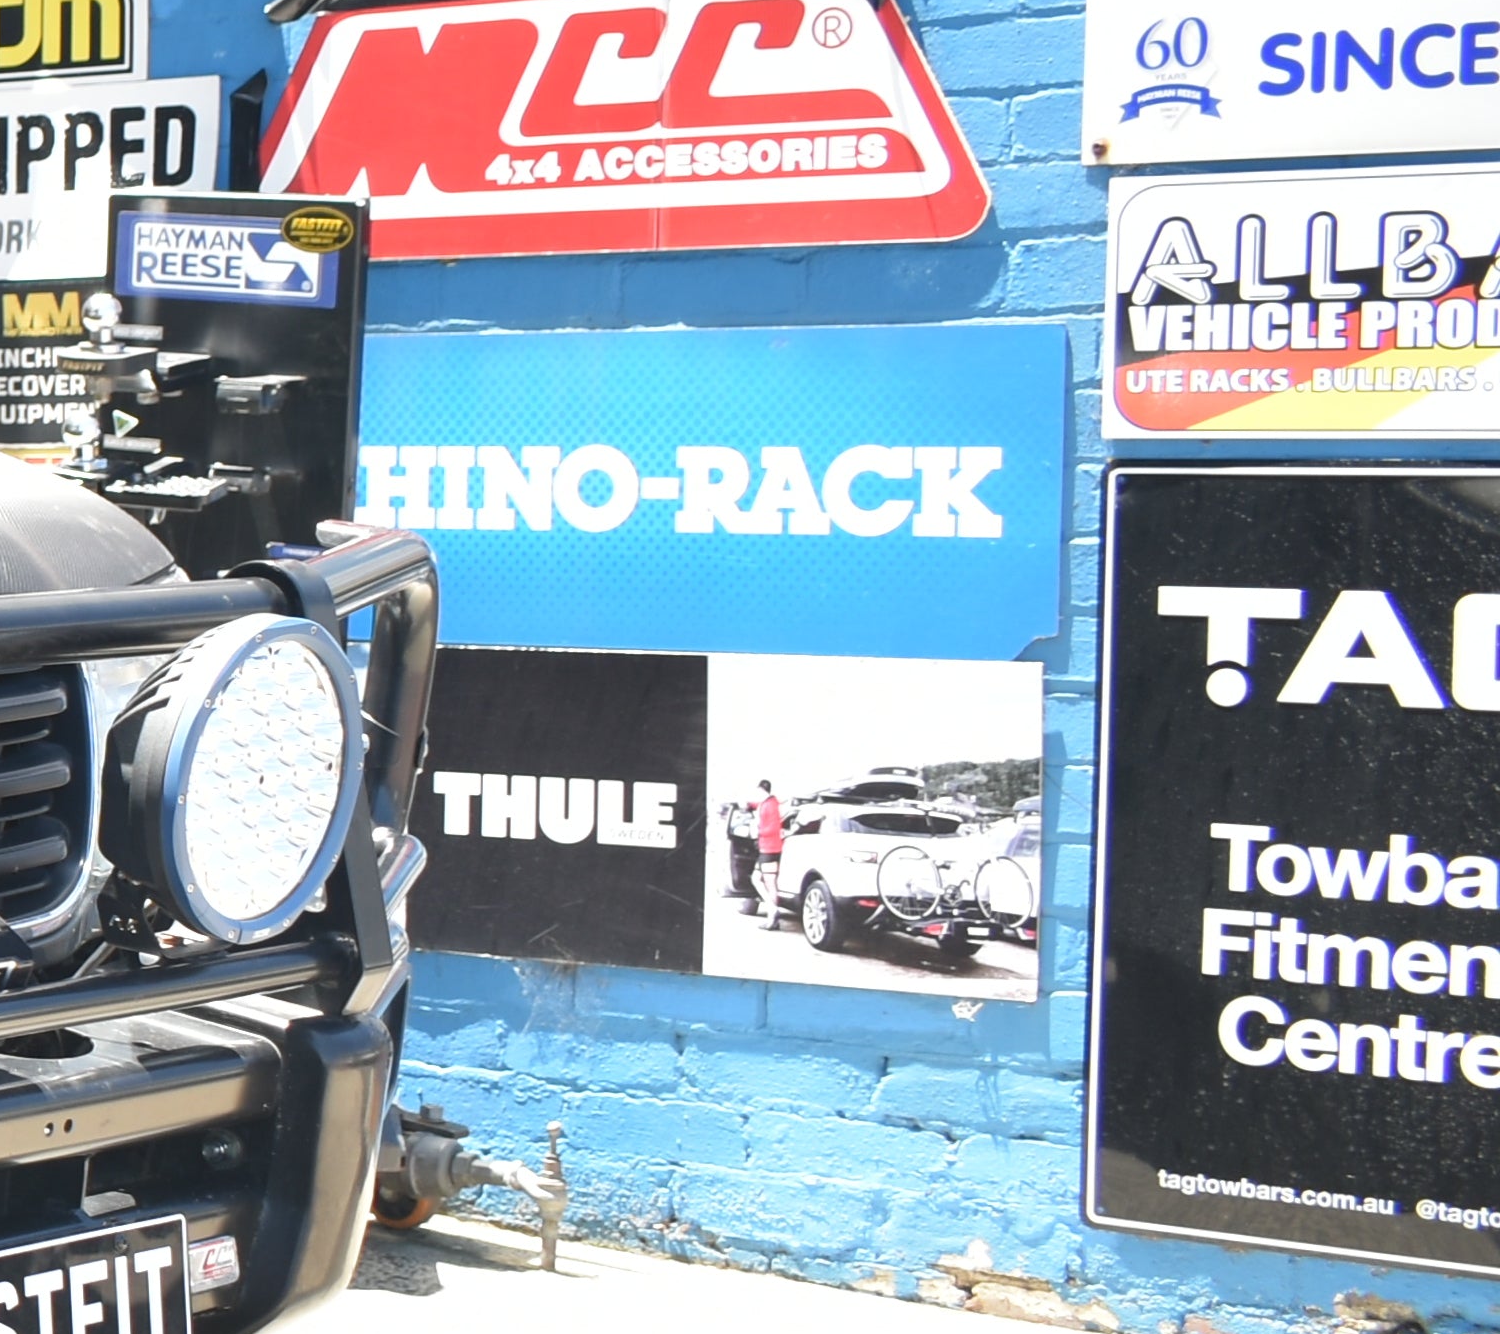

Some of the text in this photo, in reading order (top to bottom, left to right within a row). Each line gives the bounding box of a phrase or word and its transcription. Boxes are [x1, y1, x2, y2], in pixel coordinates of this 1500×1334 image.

[1135, 16, 1209, 71] 60
[1258, 20, 1500, 98] SINCE
[484, 133, 889, 187] 4x4 ACCESSORIES
[137, 226, 245, 251] HAYMAN
[290, 217, 343, 231] FASTFIT
[136, 251, 243, 284] REESE
[1128, 209, 1500, 307] ALLB
[1127, 301, 1352, 353] VEHICLE
[1125, 365, 1478, 394] UTE RACKS BULLBARS
[433, 770, 678, 848] THULE
[1210, 822, 1500, 909] Towba
[1218, 996, 1500, 1090] Centre
[1156, 1168, 1395, 1216] tagtowbars.com.au
